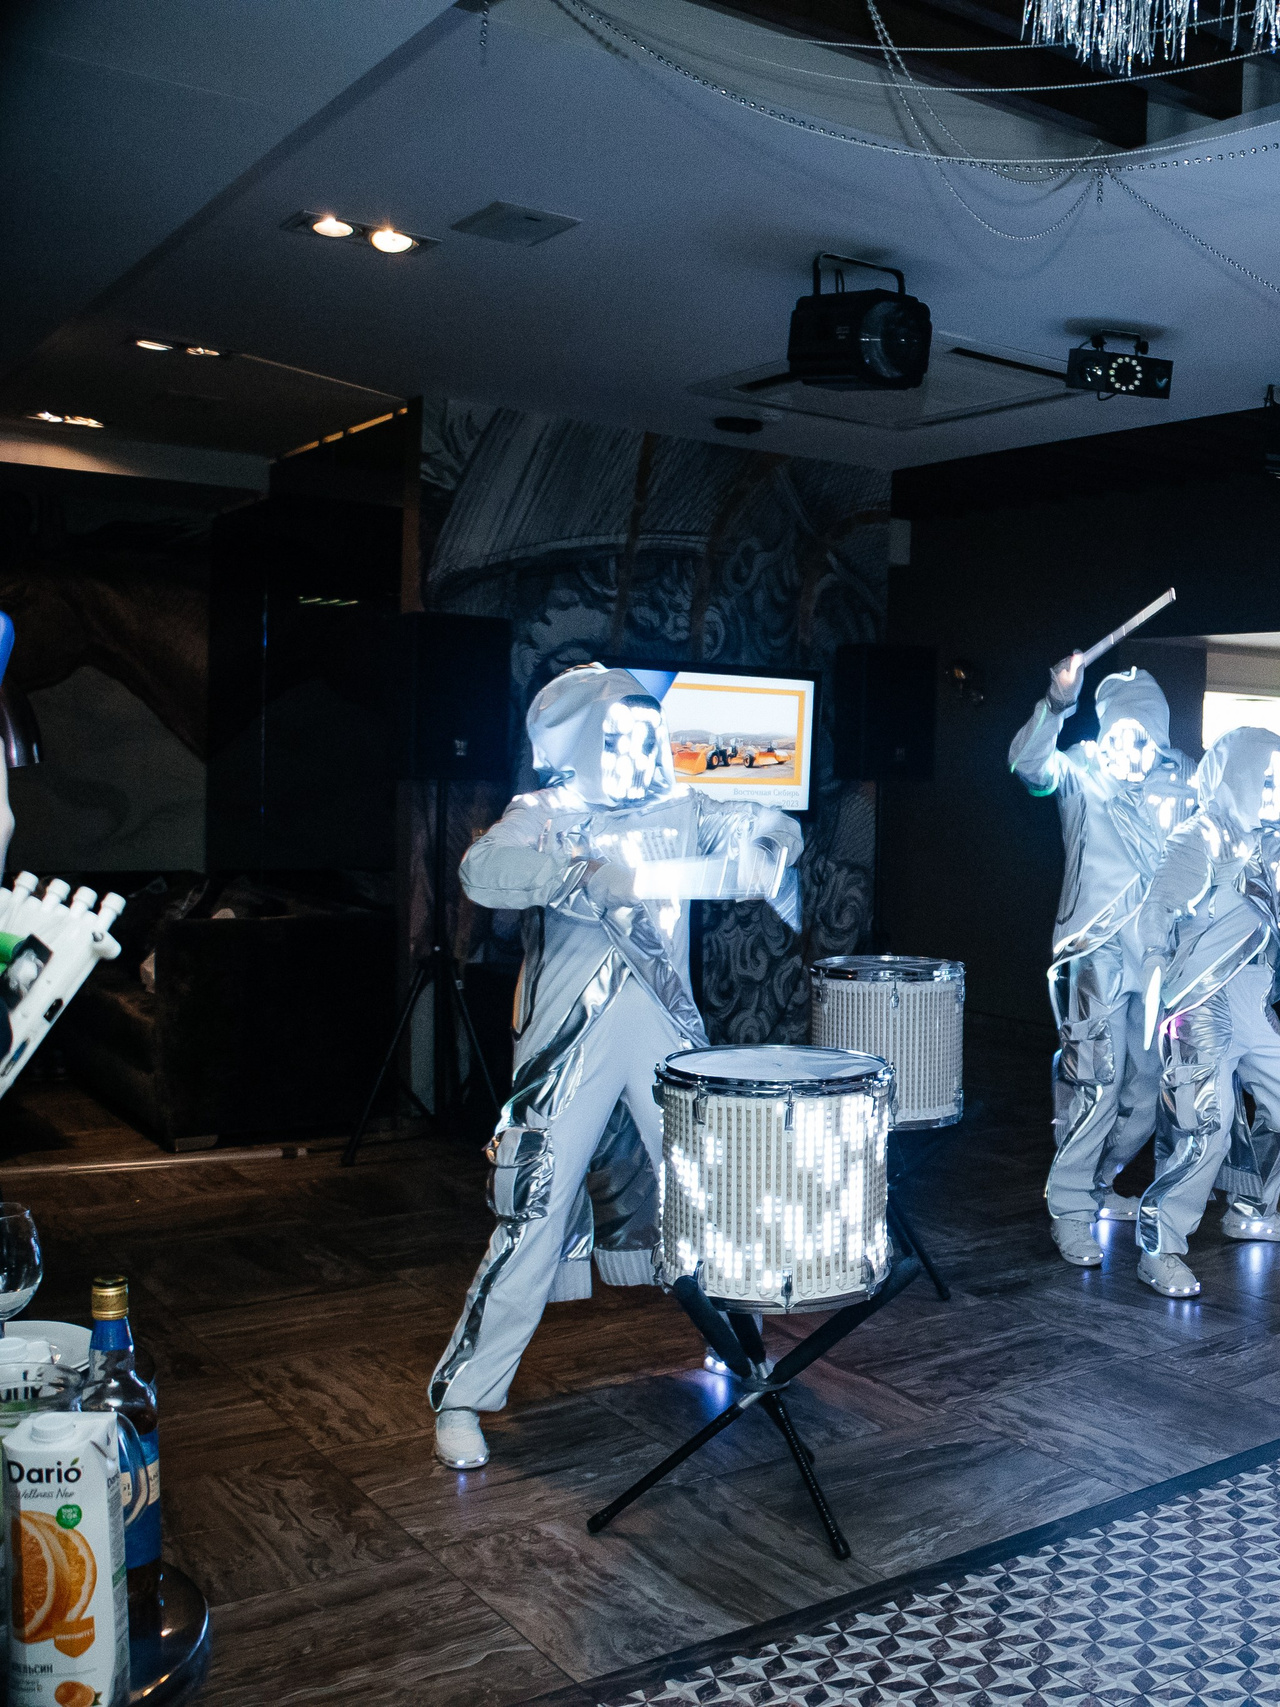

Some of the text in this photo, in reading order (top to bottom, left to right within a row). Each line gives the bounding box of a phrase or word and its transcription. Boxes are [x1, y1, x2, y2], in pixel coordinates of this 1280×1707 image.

[734, 788, 800, 798] Восточная Сибирь
[782, 799, 800, 808] 2023
